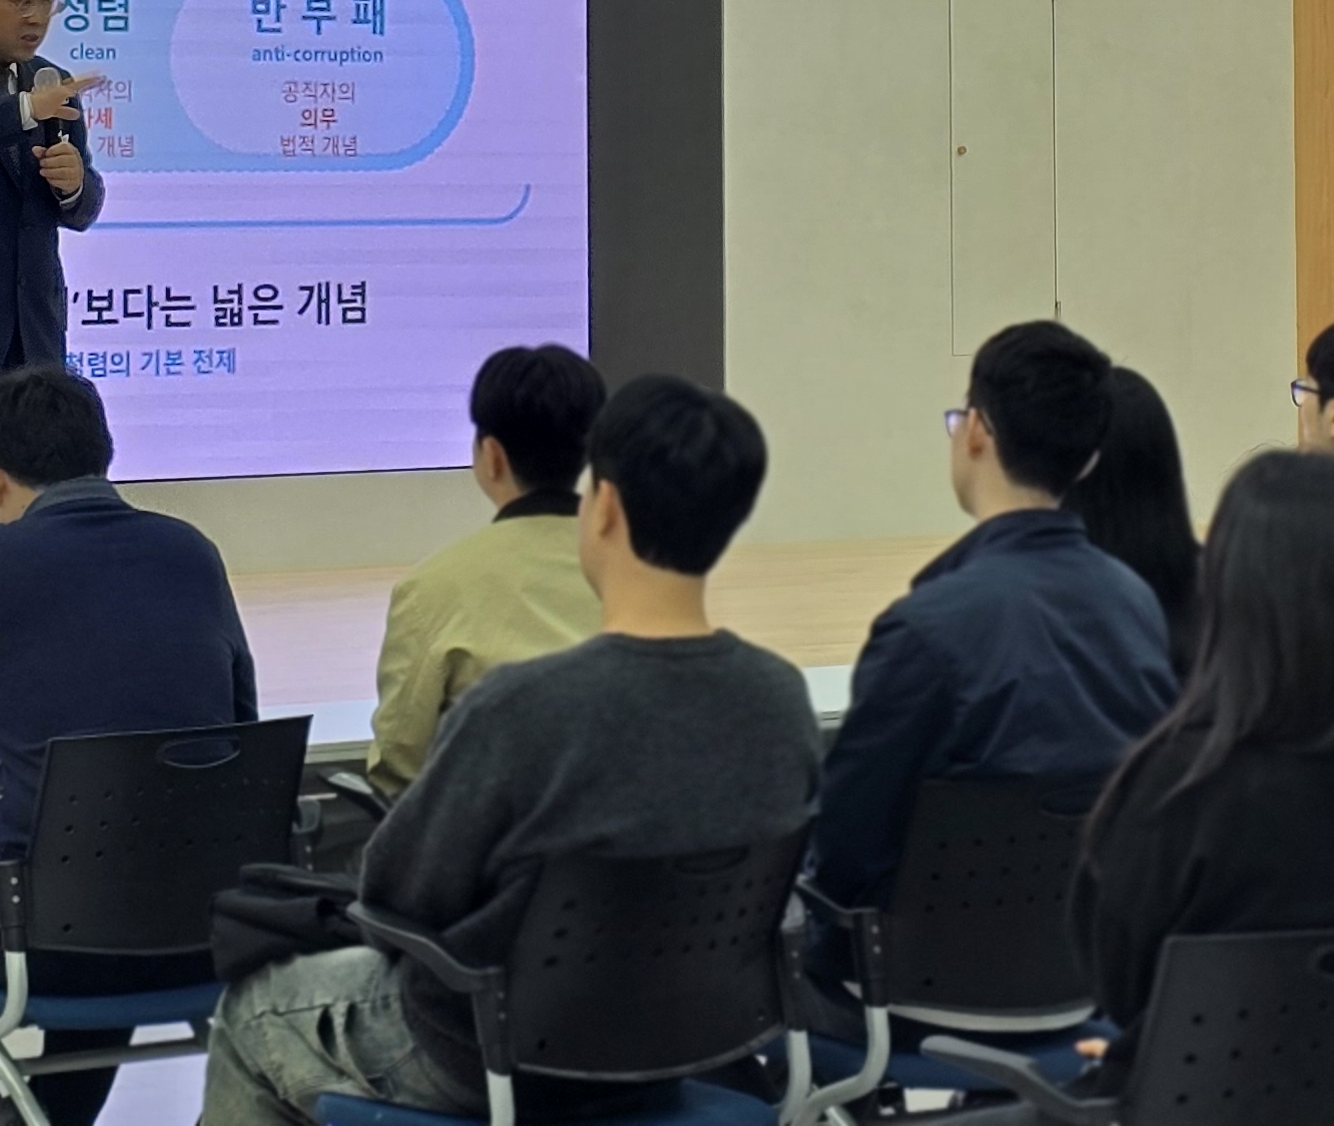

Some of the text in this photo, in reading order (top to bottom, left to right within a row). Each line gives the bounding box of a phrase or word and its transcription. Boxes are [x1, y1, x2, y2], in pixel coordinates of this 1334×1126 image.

[70, 42, 117, 60] clean
[252, 45, 383, 66] anti-corruption
[281, 80, 356, 105] 공직자의
[300, 107, 338, 130] 의무
[97, 135, 135, 158] 개념
[279, 135, 358, 158] 법적 개념
[212, 283, 284, 328] 넓은
[297, 280, 367, 325] 개념
[140, 349, 185, 375] 기본
[193, 347, 236, 374] 전제
